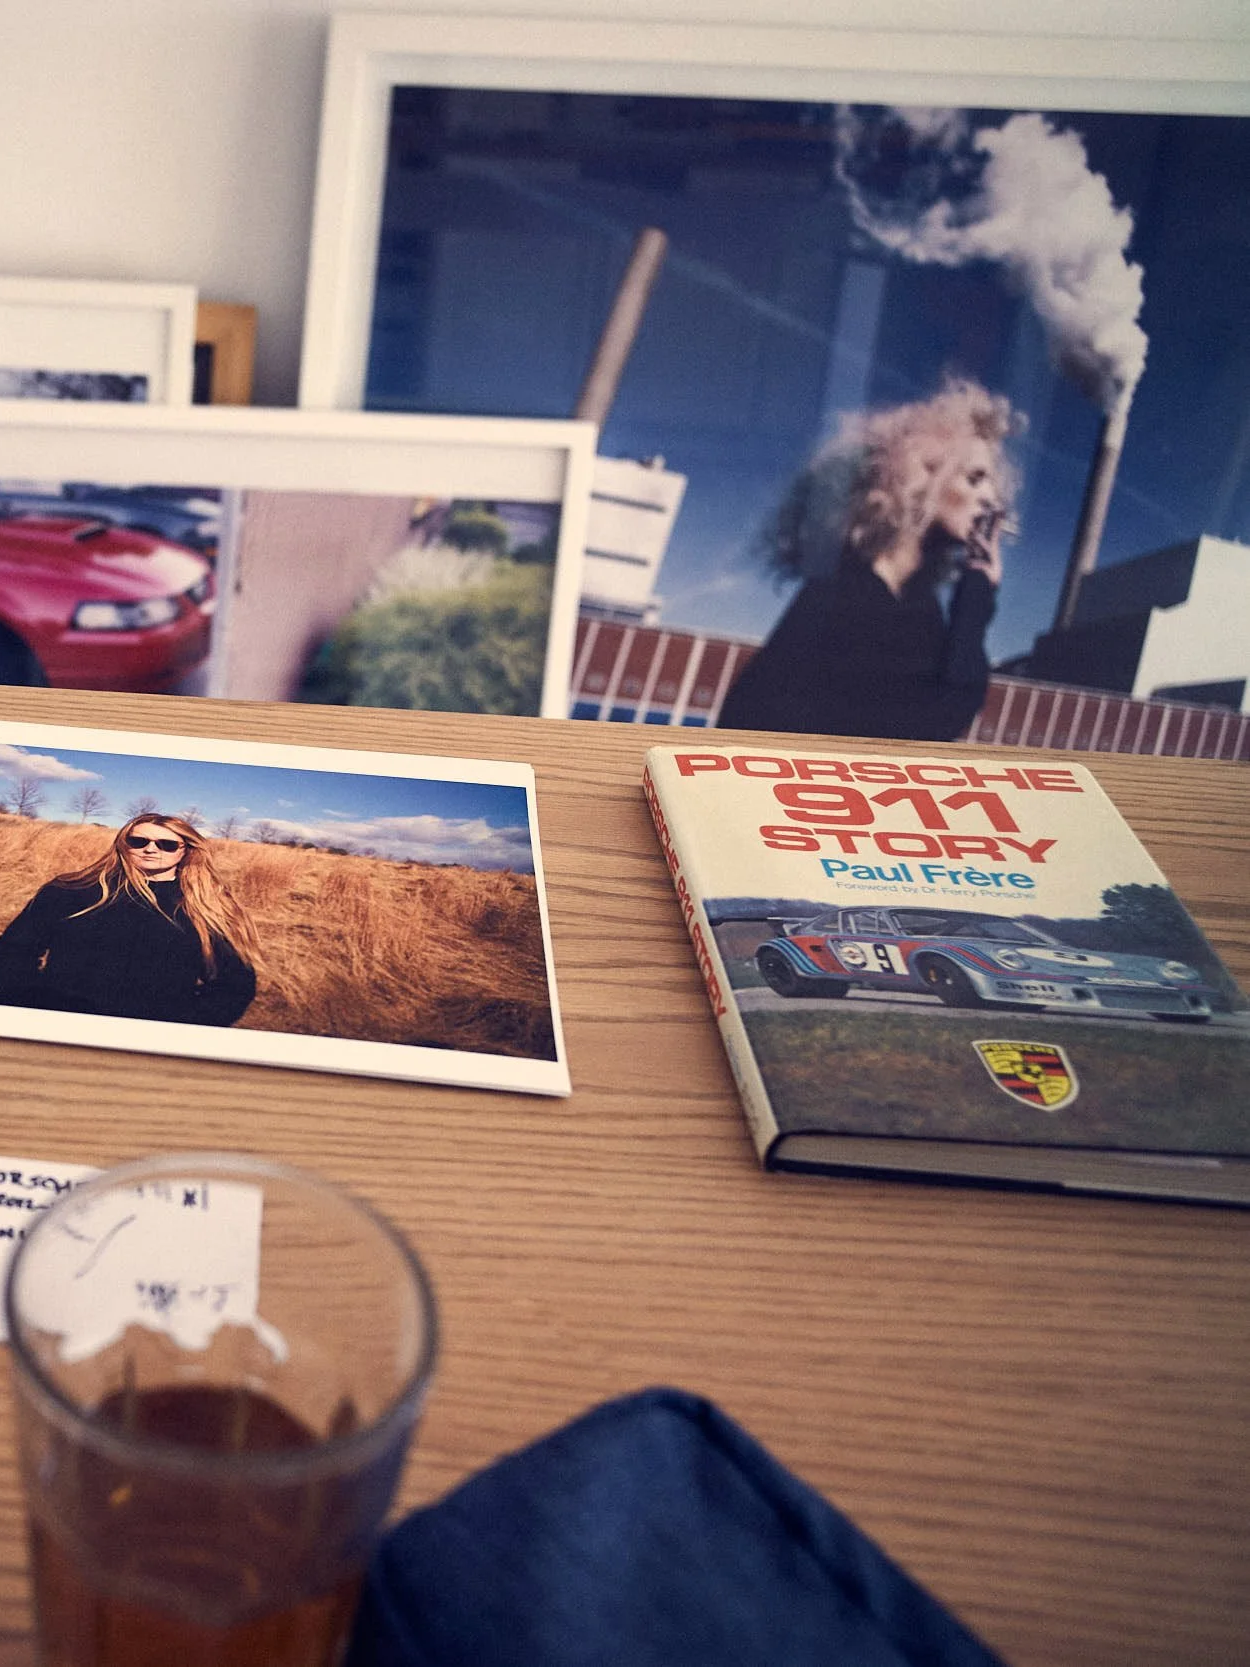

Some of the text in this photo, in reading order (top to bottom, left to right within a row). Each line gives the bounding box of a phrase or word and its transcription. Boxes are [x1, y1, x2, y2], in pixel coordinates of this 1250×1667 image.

[674, 753, 1084, 793] PORSCHE
[773, 783, 1021, 833] 911
[759, 825, 1058, 863] STORY
[643, 764, 681, 876] PORSCHE
[691, 921, 727, 1019] STORY
[820, 858, 1035, 889] Paul Frère
[872, 943, 896, 975] 9
[996, 981, 1055, 993] Shell
